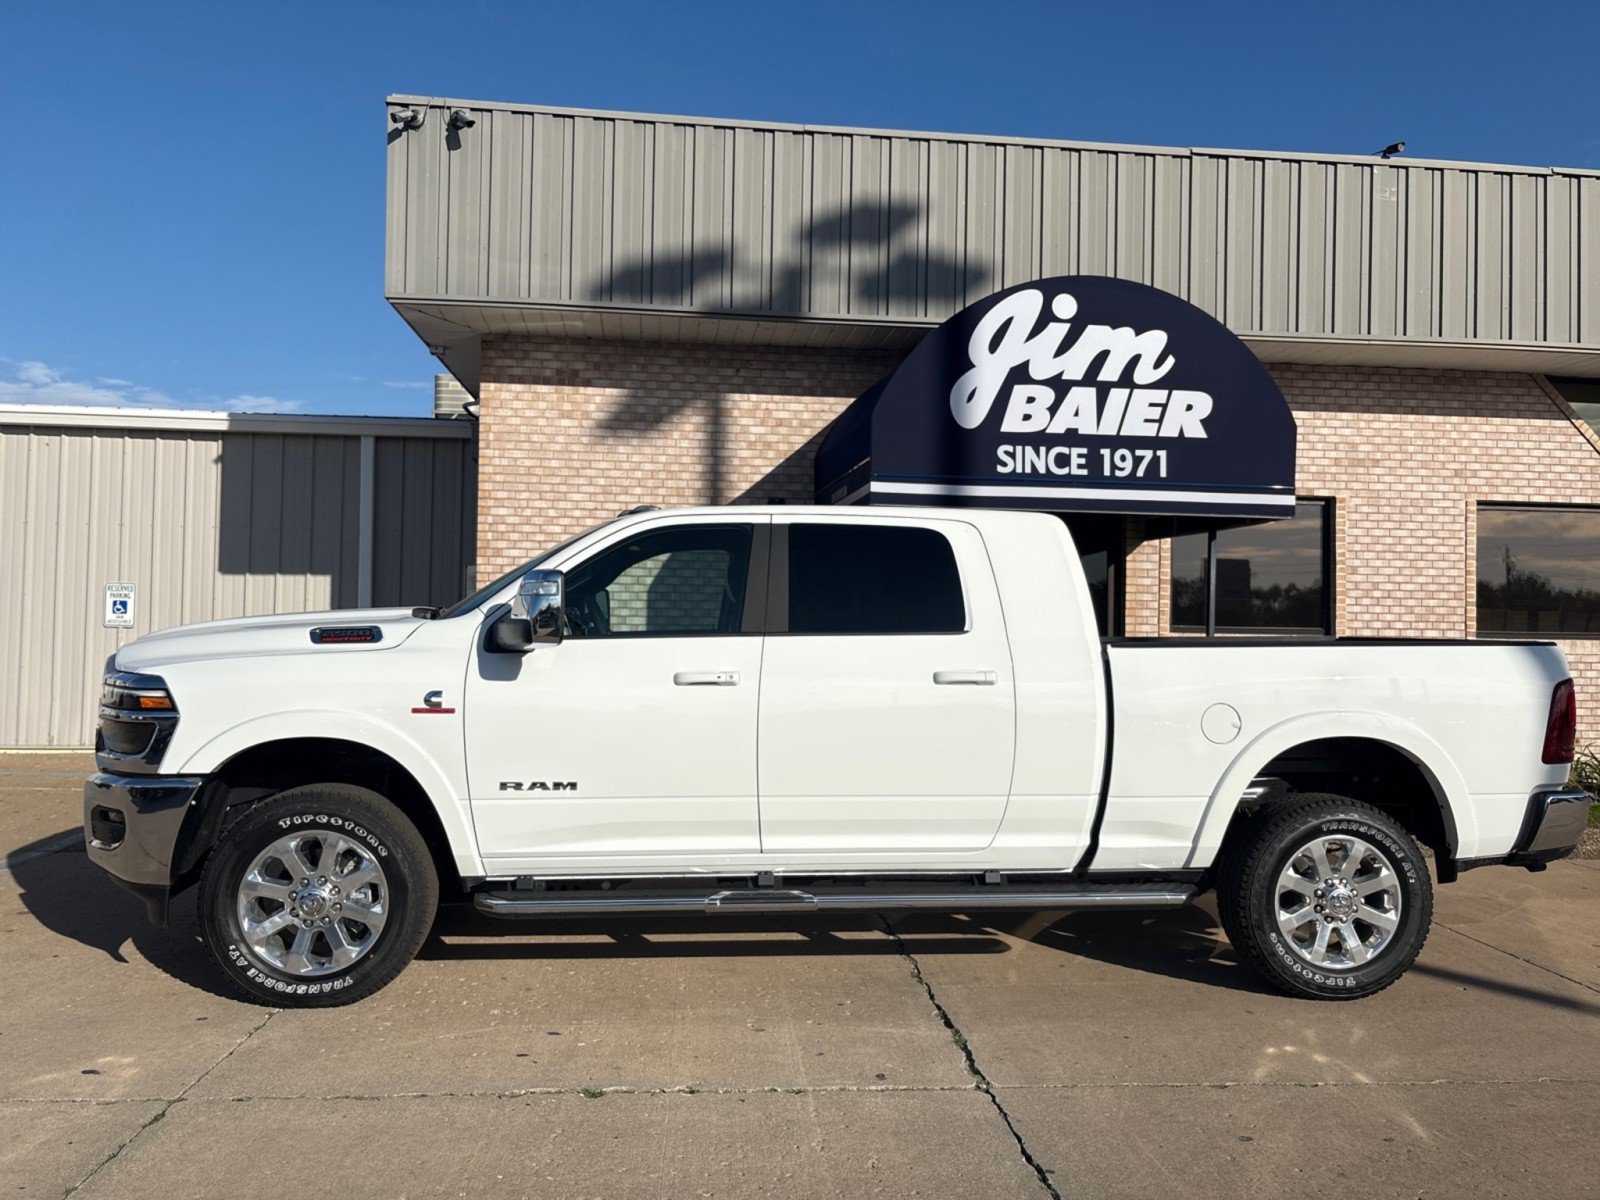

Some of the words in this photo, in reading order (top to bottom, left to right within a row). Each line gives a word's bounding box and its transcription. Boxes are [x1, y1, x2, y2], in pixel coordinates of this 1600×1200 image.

[950, 289, 1176, 430] Jim
[1000, 384, 1213, 438] BAIER
[996, 445, 1088, 476] SINCE
[1100, 447, 1168, 478] 1971
[499, 781, 578, 791] RAM
[1322, 821, 1405, 858] TRANSFORCE
[247, 967, 354, 994] TRANSFORCE
